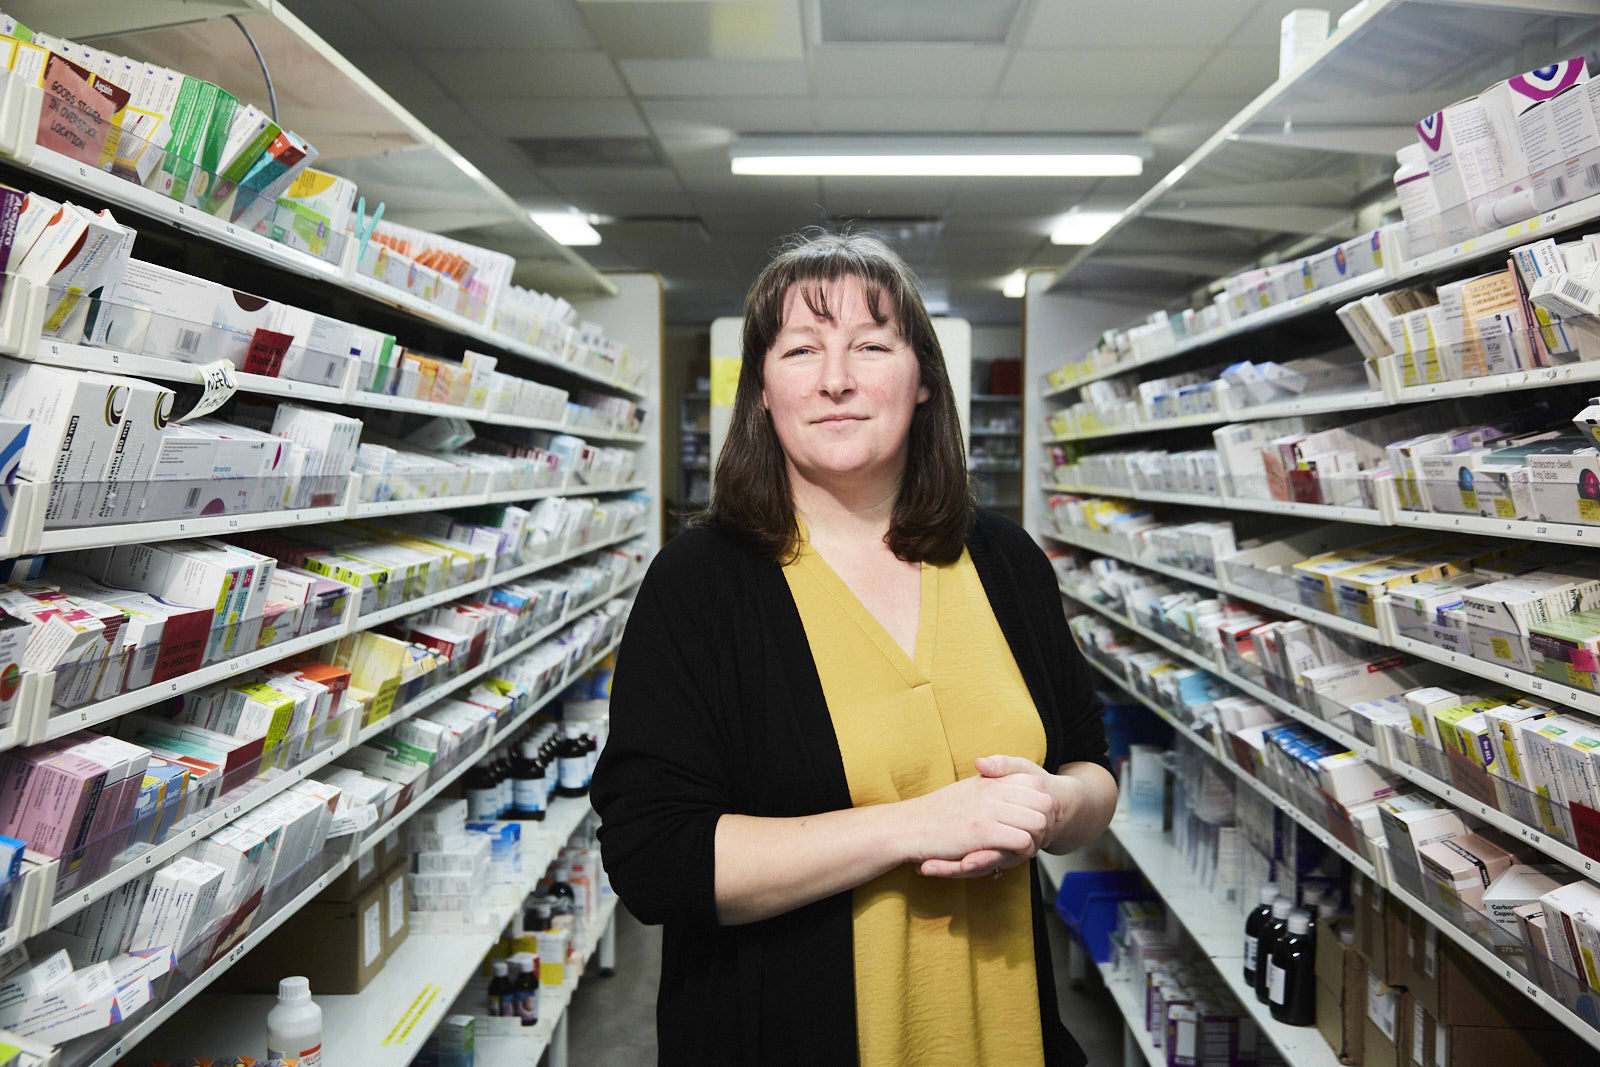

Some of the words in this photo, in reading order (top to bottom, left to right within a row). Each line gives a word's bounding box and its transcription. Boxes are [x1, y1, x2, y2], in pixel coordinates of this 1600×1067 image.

[52, 80, 76, 104] GOODS
[50, 120, 87, 150] LOCATION
[1542, 256, 1550, 265] mg
[67, 415, 78, 434] mg
[121, 420, 130, 438] mg
